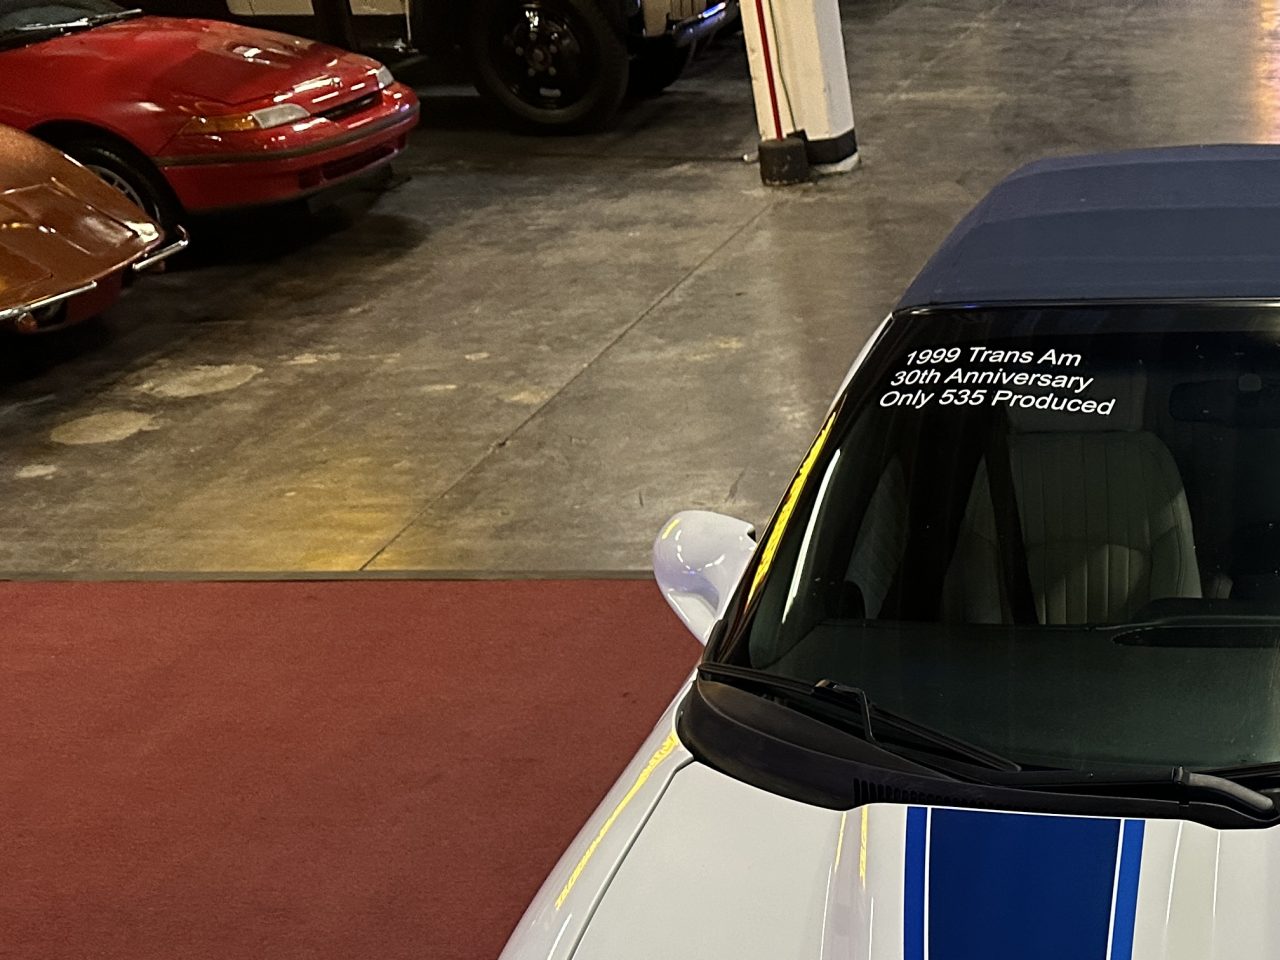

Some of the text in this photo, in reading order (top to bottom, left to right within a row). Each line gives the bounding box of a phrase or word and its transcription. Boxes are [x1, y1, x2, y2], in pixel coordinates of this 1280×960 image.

[906, 346, 1082, 367] 1999 Trans Am
[890, 367, 1095, 394] 30th Anniversary
[879, 388, 1116, 416] Only 535 Produced
